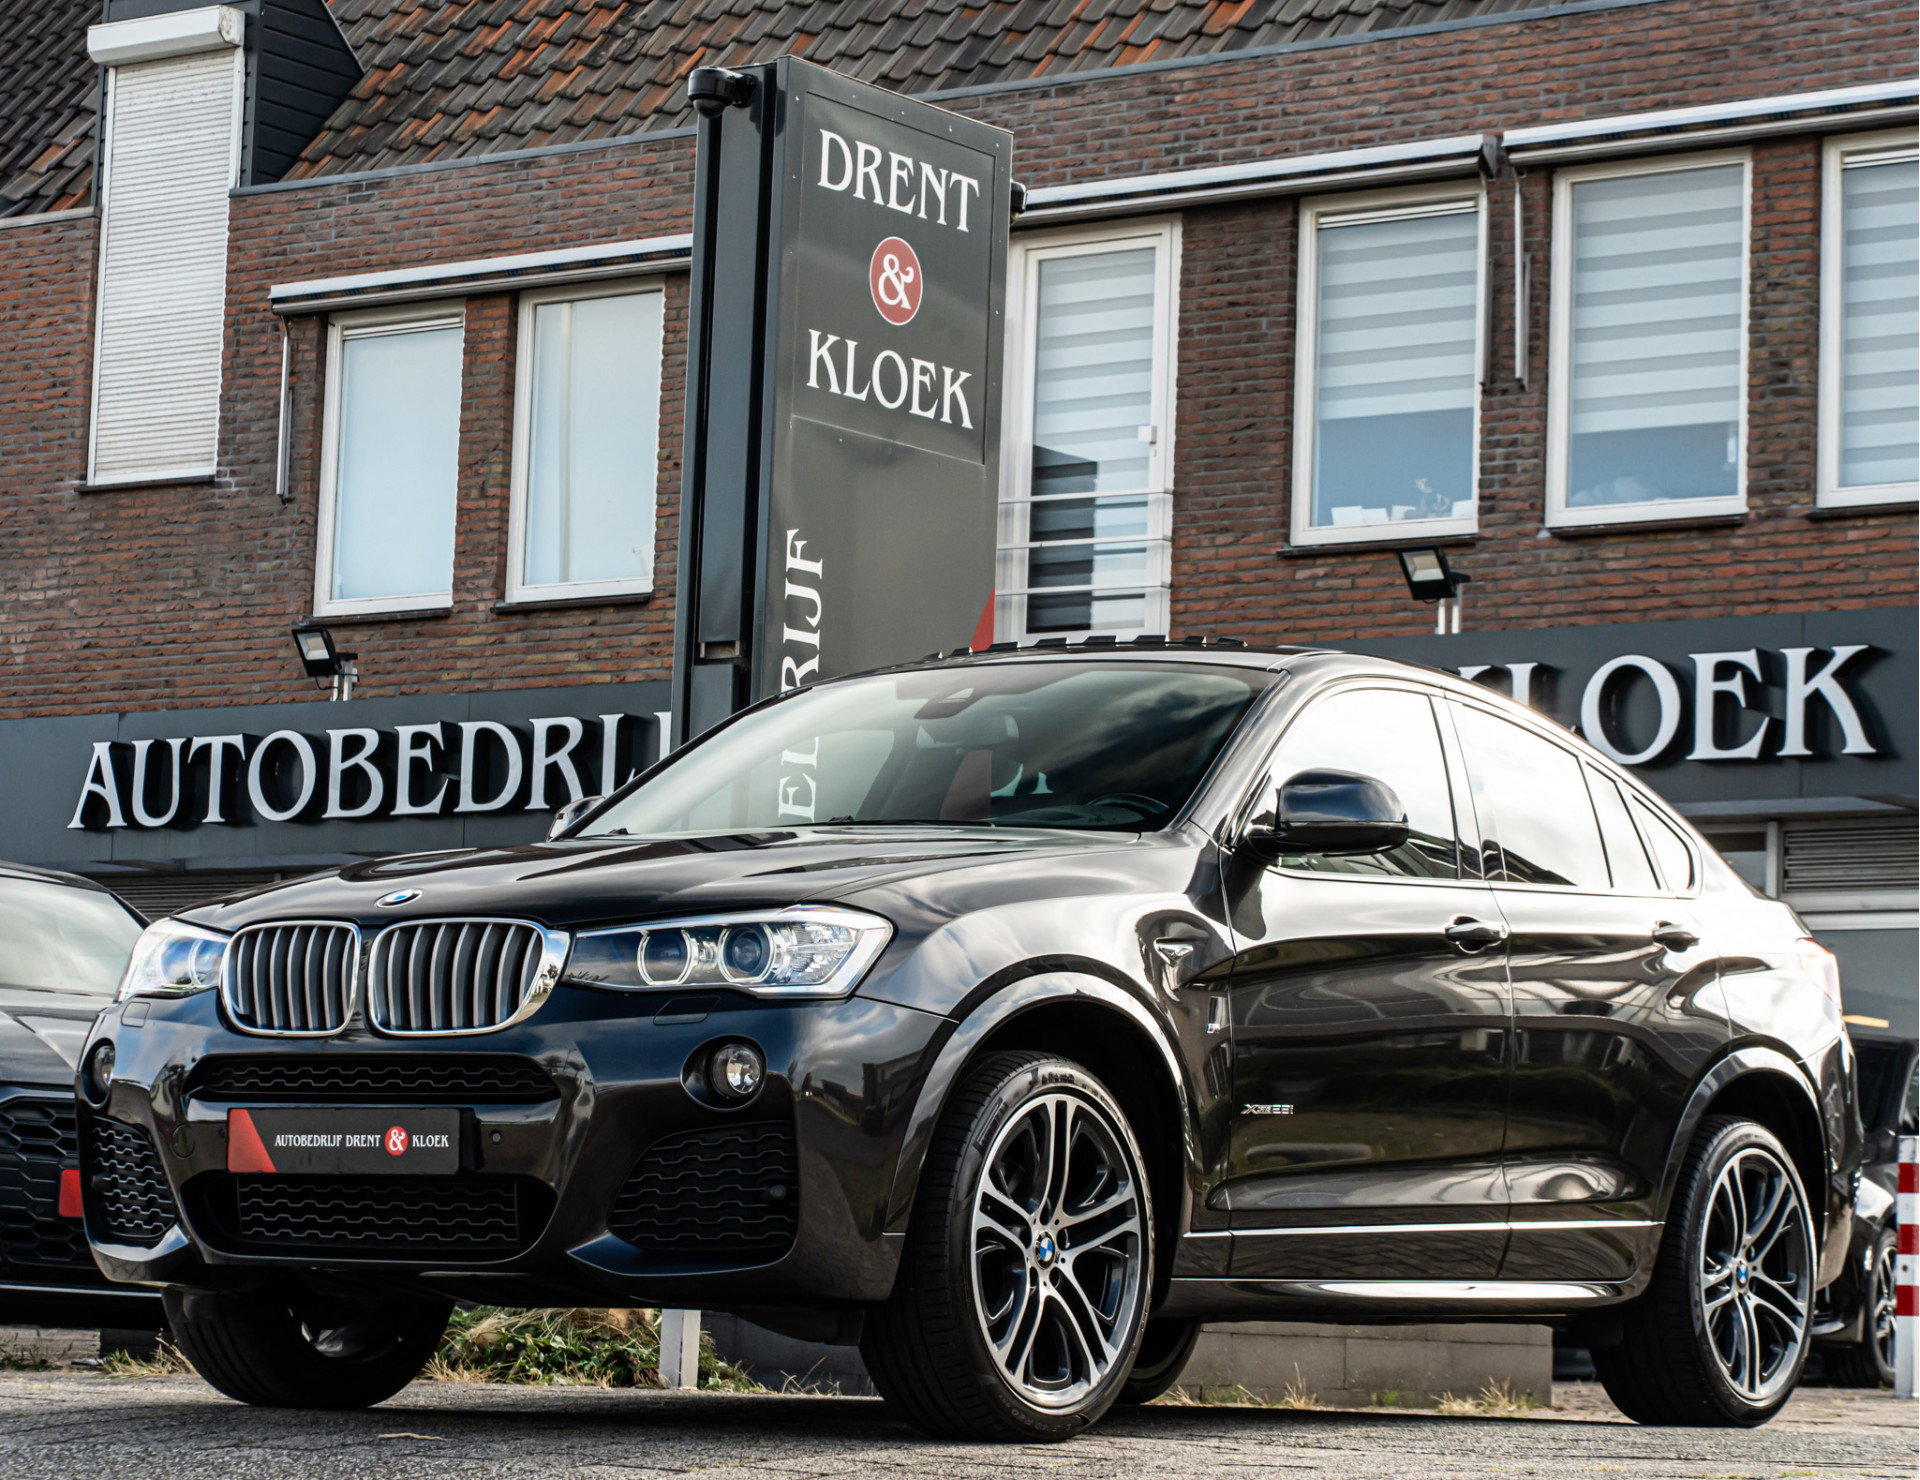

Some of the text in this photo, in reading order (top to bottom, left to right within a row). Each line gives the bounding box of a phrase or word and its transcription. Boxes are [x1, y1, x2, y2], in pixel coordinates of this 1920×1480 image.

[817, 128, 980, 233] DRENT
[877, 253, 915, 310] &
[806, 328, 974, 430] KLOEK
[1458, 644, 1878, 766] OEK
[274, 1128, 450, 1151] AUTOBEDRIJF DRENT & KLOEK
